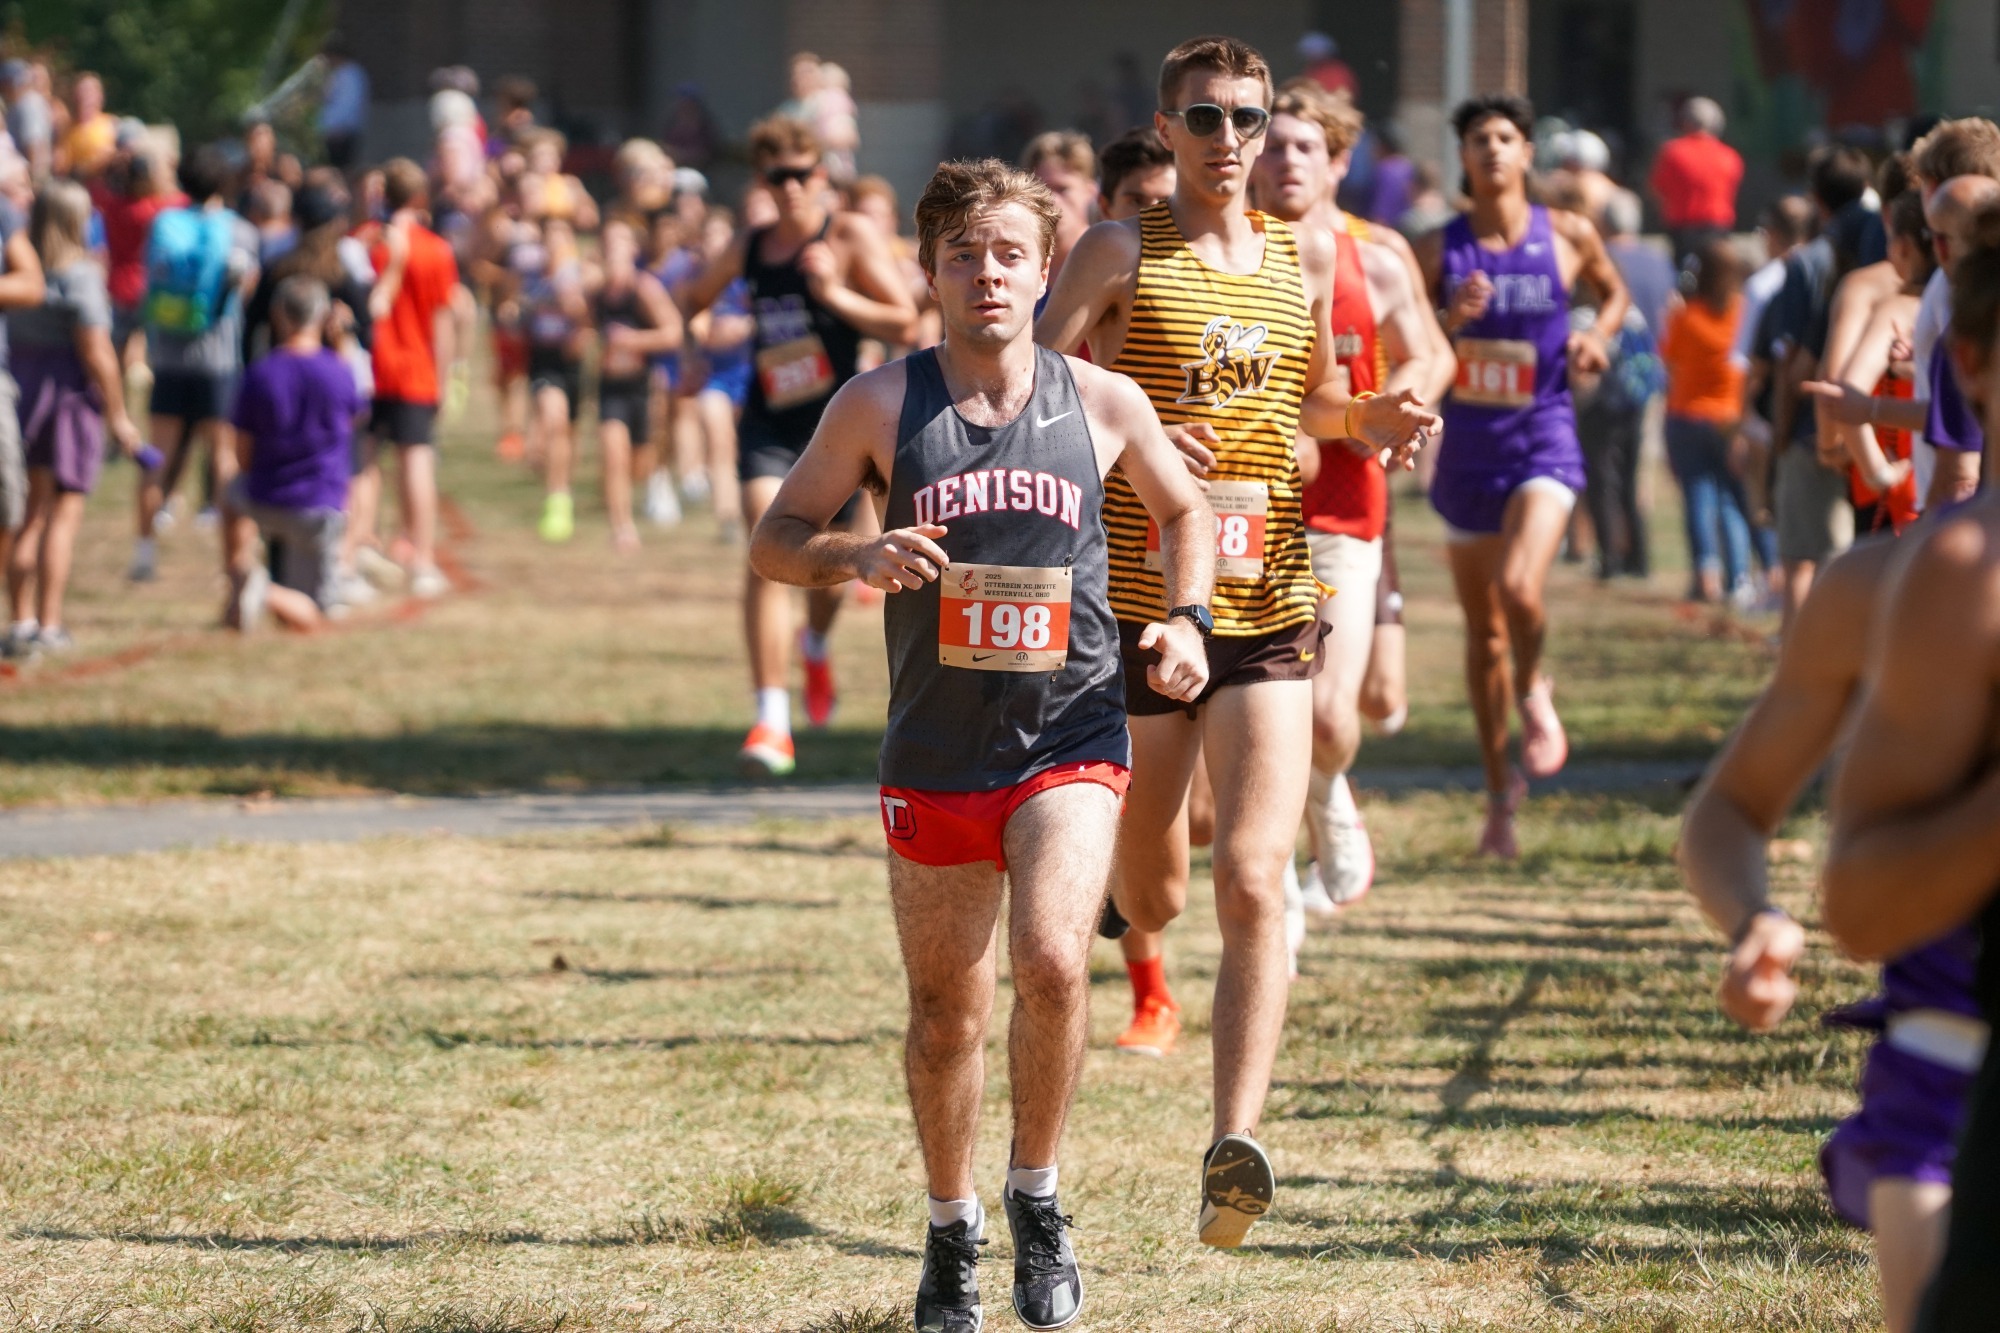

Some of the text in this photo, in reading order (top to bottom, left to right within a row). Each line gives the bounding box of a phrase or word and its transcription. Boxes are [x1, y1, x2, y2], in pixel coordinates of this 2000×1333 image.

[1466, 361, 1518, 393] 161
[913, 468, 1083, 532] DENISON
[984, 581, 1022, 589] OTTERBEIN
[962, 602, 1051, 649] 198
[882, 795, 917, 840] D
